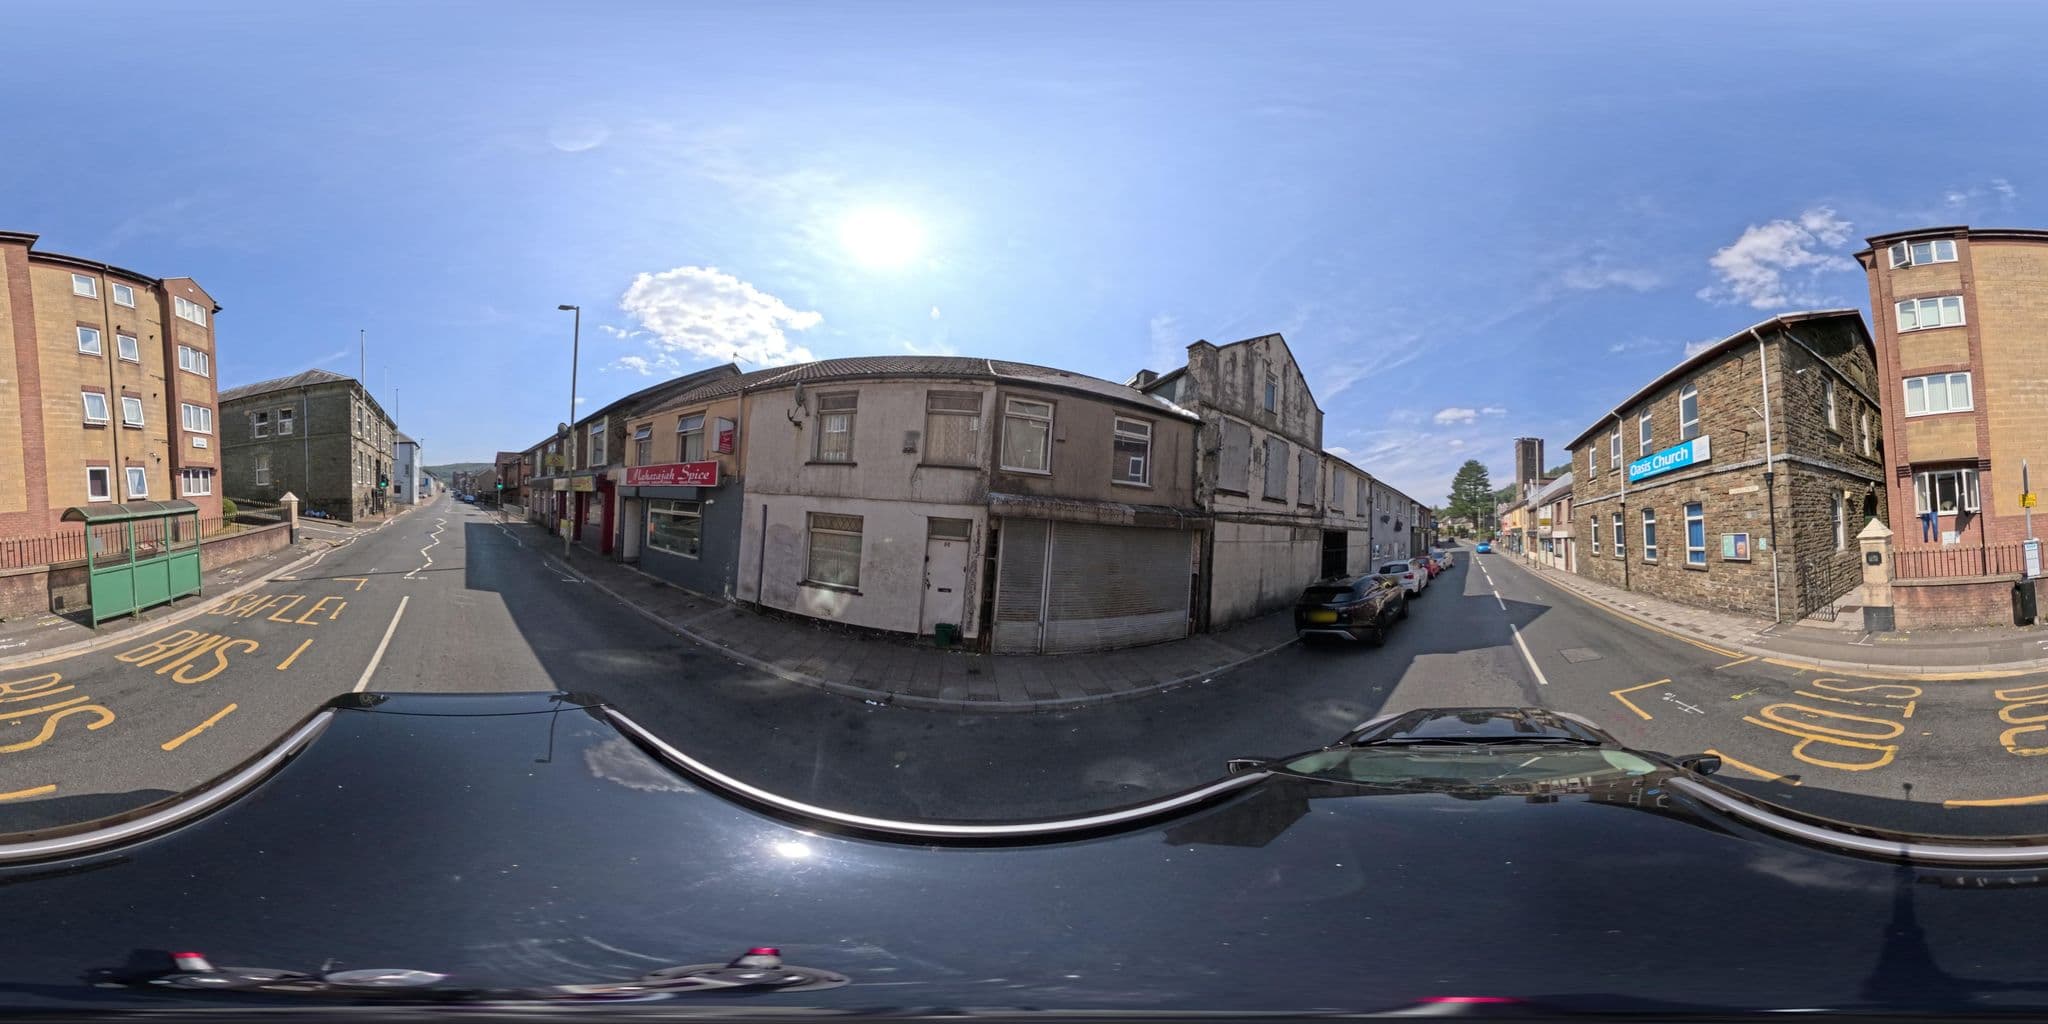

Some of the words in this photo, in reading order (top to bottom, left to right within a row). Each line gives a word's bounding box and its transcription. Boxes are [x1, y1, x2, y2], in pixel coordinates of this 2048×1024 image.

[633, 468, 675, 482] Maharajah
[677, 465, 710, 482] Spice
[1630, 462, 1651, 476] Oasis
[1653, 447, 1688, 469] Church
[208, 594, 344, 625] SAFLE
[1743, 678, 1922, 771] STOP
